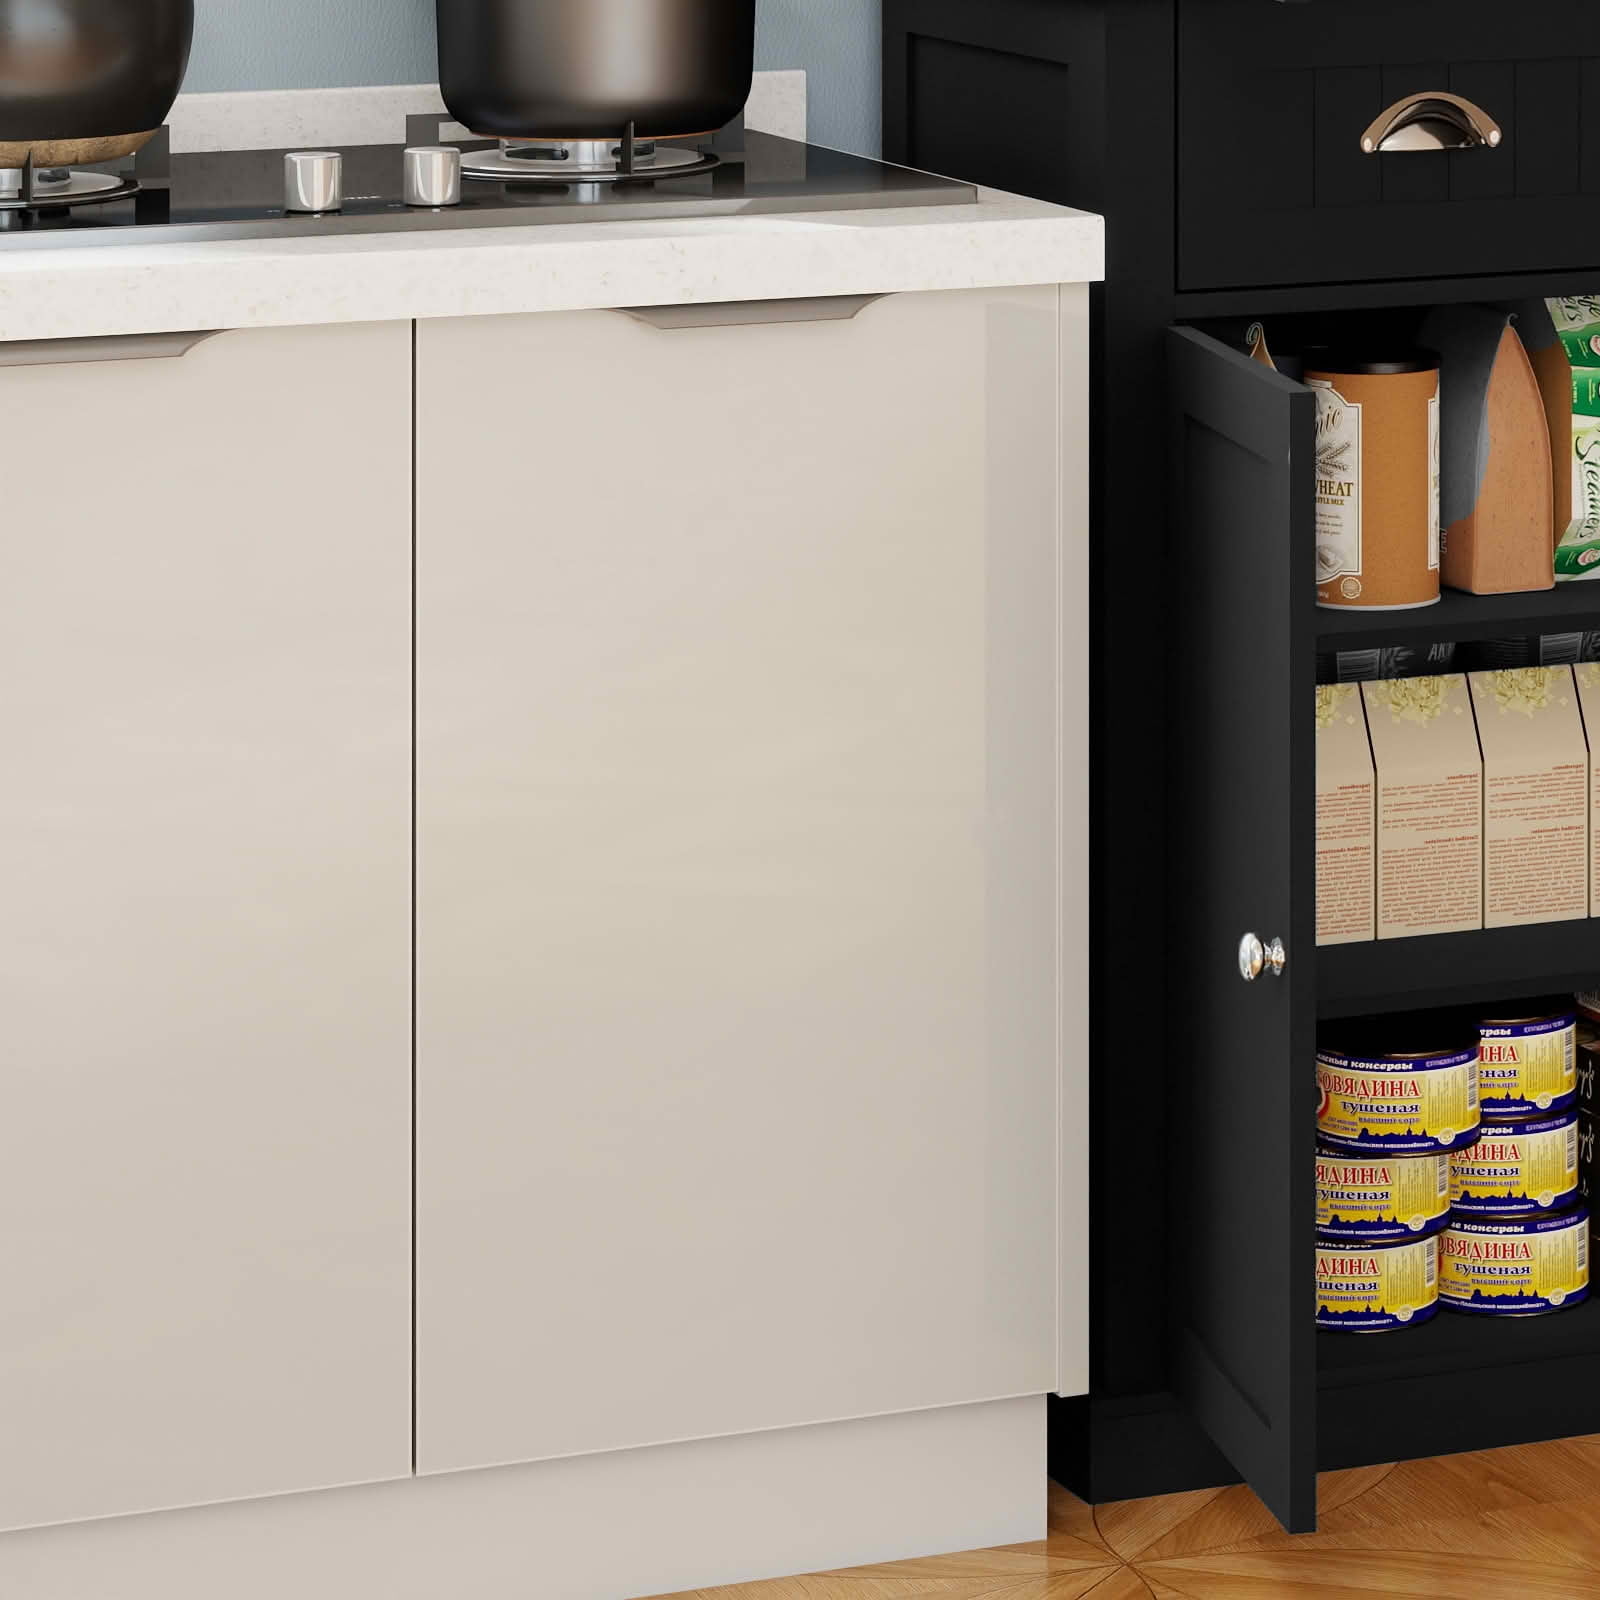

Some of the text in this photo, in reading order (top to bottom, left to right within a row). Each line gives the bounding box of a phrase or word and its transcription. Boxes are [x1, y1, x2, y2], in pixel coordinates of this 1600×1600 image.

[1351, 1061, 1413, 1071] консервы
[1341, 1101, 1420, 1116] тушеная
[1450, 1166, 1519, 1177] ушеная
[1464, 1224, 1525, 1234] консервы
[1455, 1263, 1531, 1277] тушеная
